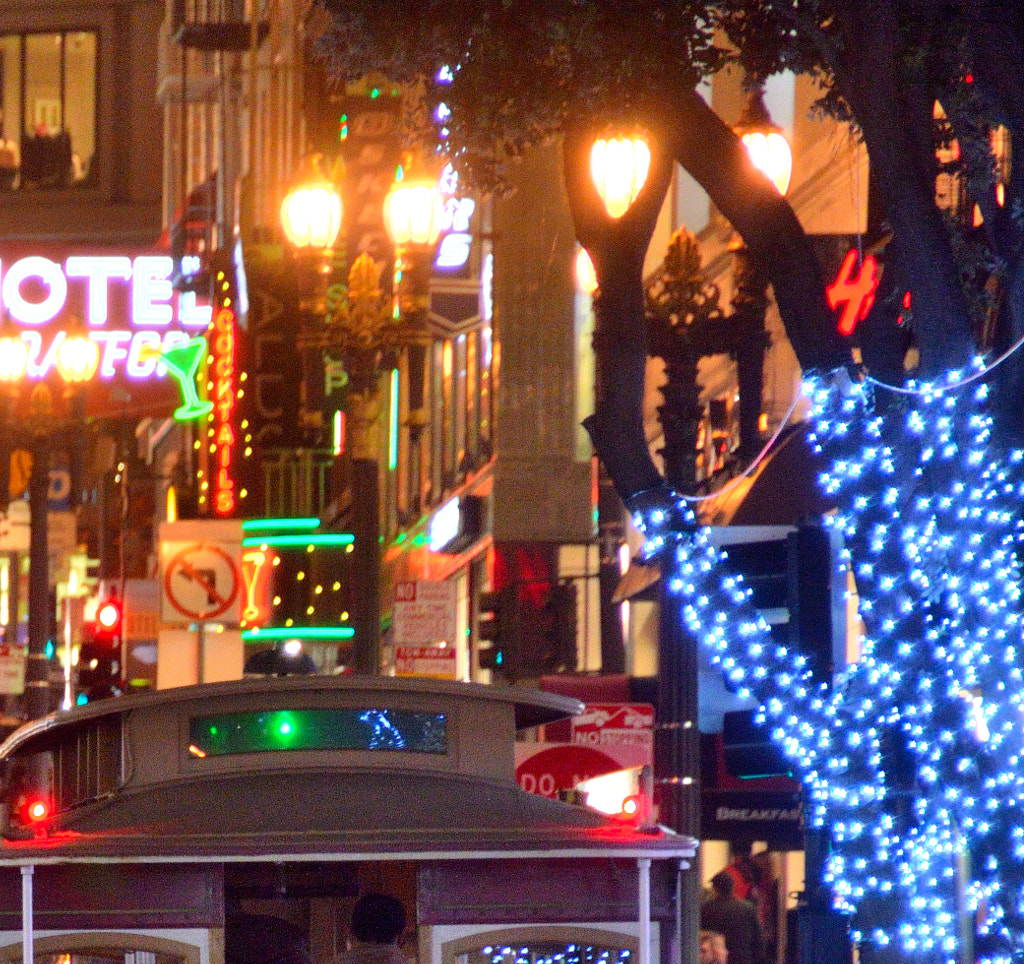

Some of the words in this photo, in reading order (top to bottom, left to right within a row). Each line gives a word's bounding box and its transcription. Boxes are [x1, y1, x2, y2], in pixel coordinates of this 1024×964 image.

[215, 308, 235, 516] COCKTAILS
[521, 773, 555, 796] DO
[716, 806, 802, 821] BREAKFAS
